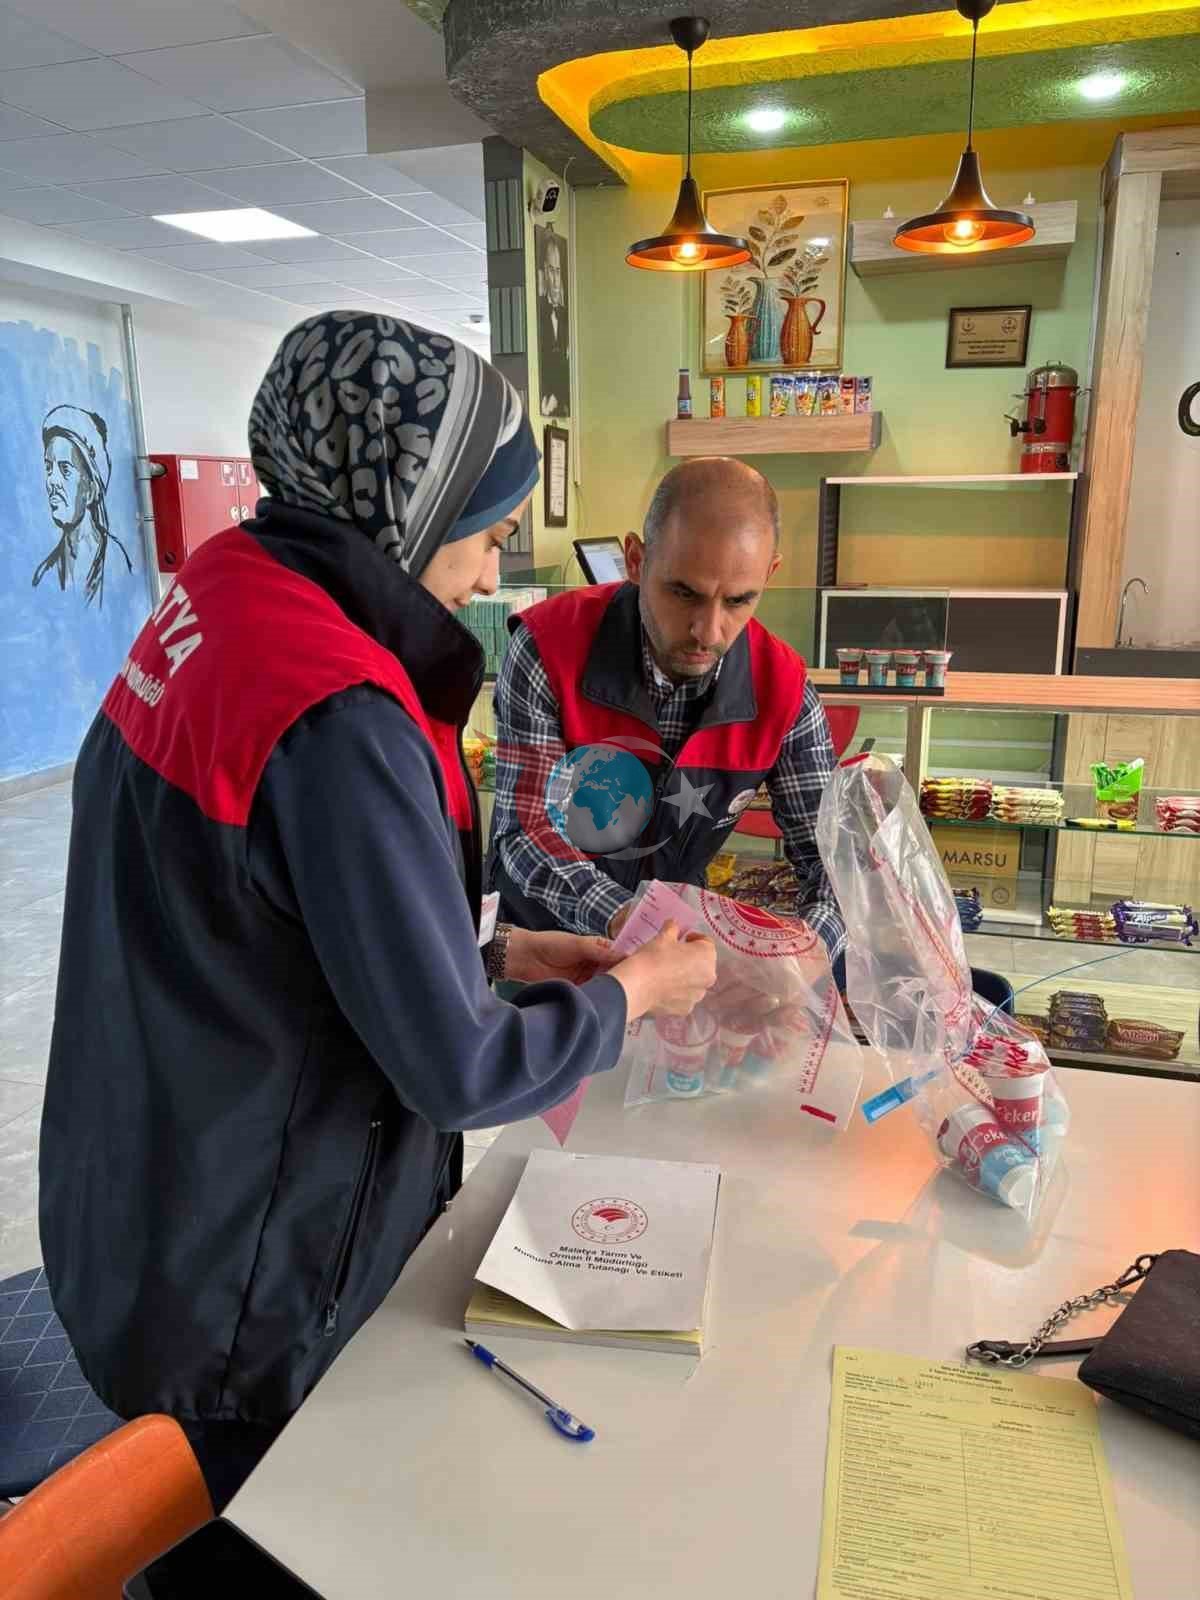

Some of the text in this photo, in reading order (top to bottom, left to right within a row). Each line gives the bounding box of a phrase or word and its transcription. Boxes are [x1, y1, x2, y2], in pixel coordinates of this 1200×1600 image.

[153, 583, 203, 678] TYA
[943, 850, 1007, 868] MARSU
[550, 1251, 584, 1262] Orman
[559, 1246, 597, 1256] Malatya
[513, 1246, 554, 1265] Numune
[554, 1260, 581, 1270] Alma
[635, 1267, 648, 1276] Ve
[651, 1269, 683, 1279] Etiketi
